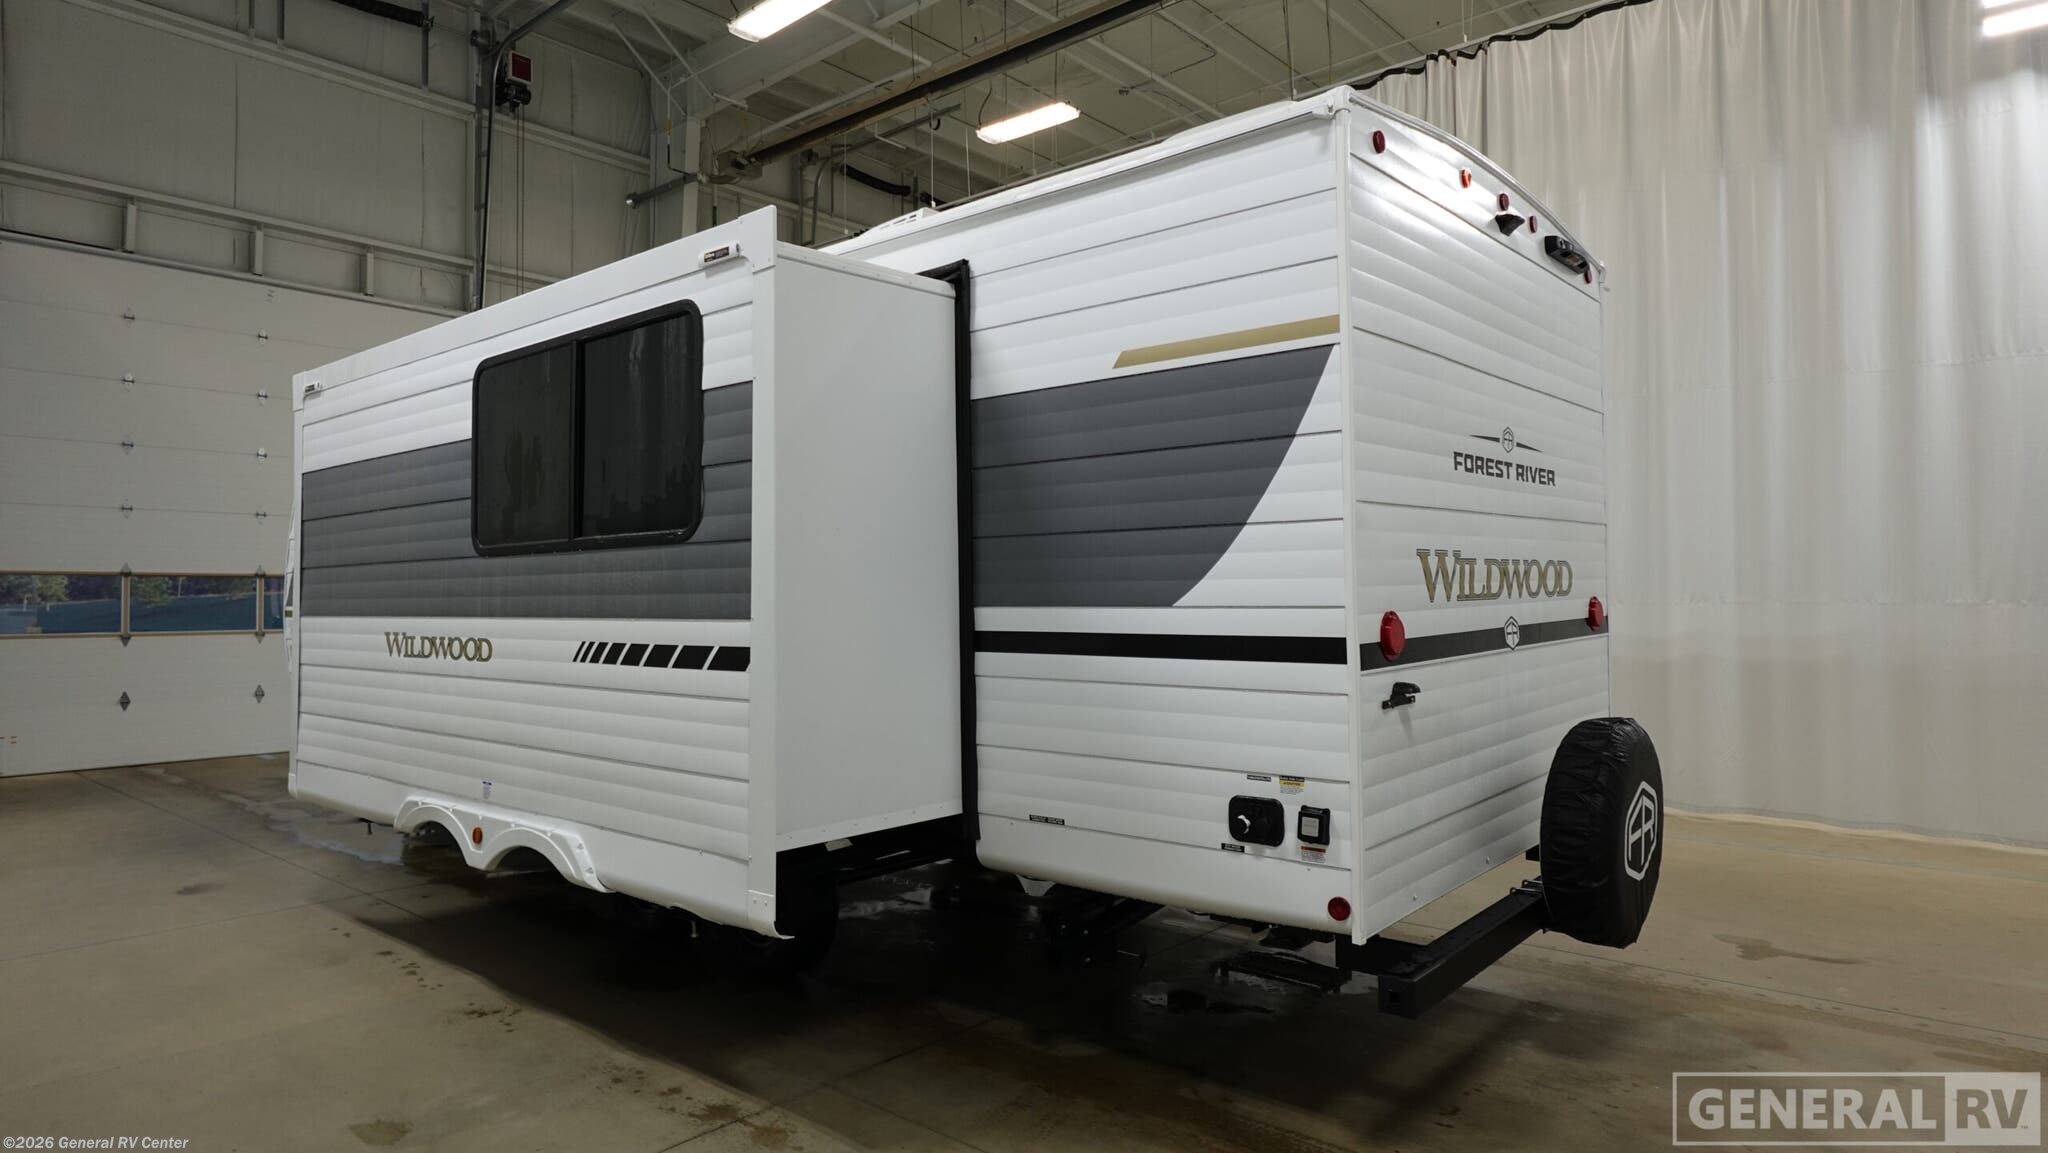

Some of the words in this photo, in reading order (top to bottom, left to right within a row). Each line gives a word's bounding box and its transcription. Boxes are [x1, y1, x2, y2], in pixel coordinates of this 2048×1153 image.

[1453, 451, 1513, 479] FOREST
[1515, 463, 1556, 487] RIVER
[1416, 548, 1573, 603] WILDWOOD
[384, 631, 493, 663] WILDWOOD
